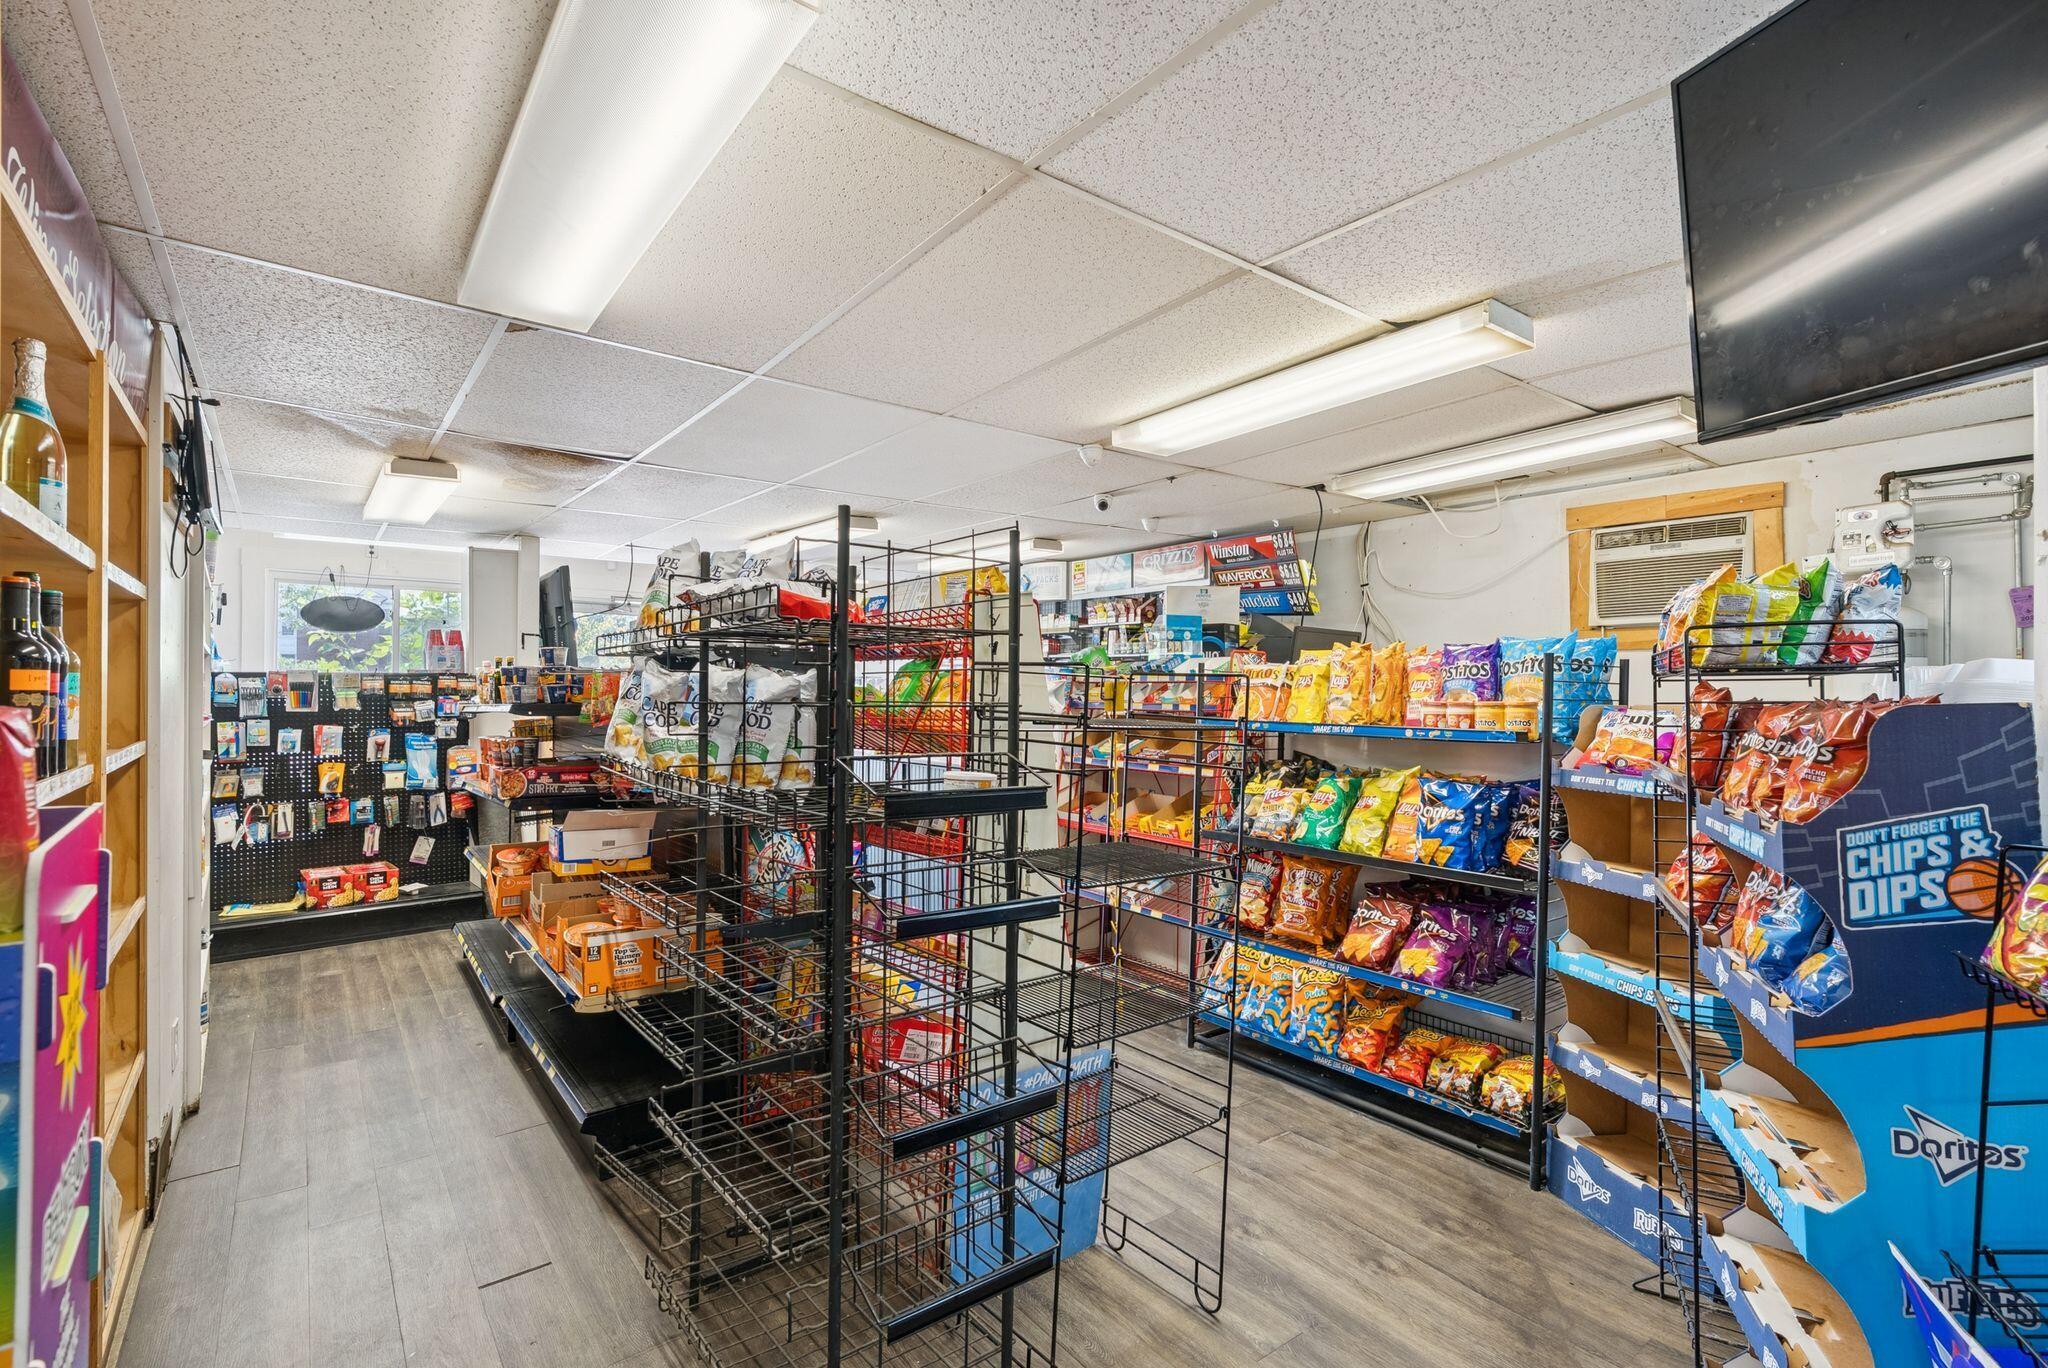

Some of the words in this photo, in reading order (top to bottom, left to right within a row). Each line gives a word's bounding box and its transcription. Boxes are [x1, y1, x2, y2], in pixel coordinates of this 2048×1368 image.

[1209, 544, 1250, 560] Winston
[1217, 569, 1270, 583] MAVERICK
[1240, 594, 1280, 608] ontclair
[1440, 661, 1490, 680] OSTITOS
[641, 696, 678, 716] CAPE
[691, 694, 725, 715] CPE
[643, 712, 679, 728] COD
[742, 714, 772, 730] OD
[1506, 718, 1532, 728] OSTITOS
[1312, 725, 1331, 734] SHARE
[1341, 726, 1355, 734] FUN
[528, 784, 545, 795] STIR
[545, 783, 559, 794] FRY
[1586, 777, 1605, 785] FORGET
[1606, 779, 1615, 787] THE
[1616, 778, 1645, 794] CHIPS
[1645, 781, 1655, 795] &
[1416, 802, 1466, 822] Doritos
[1846, 827, 1890, 847] DON'T
[1891, 817, 1949, 840] FORGET
[1950, 811, 1981, 830] THE
[1846, 834, 1952, 880] CHIPS
[1960, 828, 1994, 860] &
[1848, 869, 1950, 920] DIPS
[614, 948, 628, 956] Top
[614, 953, 641, 961] Ramen
[617, 958, 638, 966] Bowl
[1308, 957, 1327, 969] SHARE
[1336, 964, 1350, 974] FUN
[1616, 978, 1644, 998] CHIPS
[1024, 1054, 1104, 1089] #PARTMATH
[1312, 1054, 1332, 1067] SHARE
[1341, 1064, 1356, 1075] FUN
[1892, 1128, 2026, 1168] Doritos
[1568, 1165, 1611, 1204] Doritos
[1741, 1150, 1760, 1184] CHIPS
[1766, 1183, 1784, 1221] DIPS
